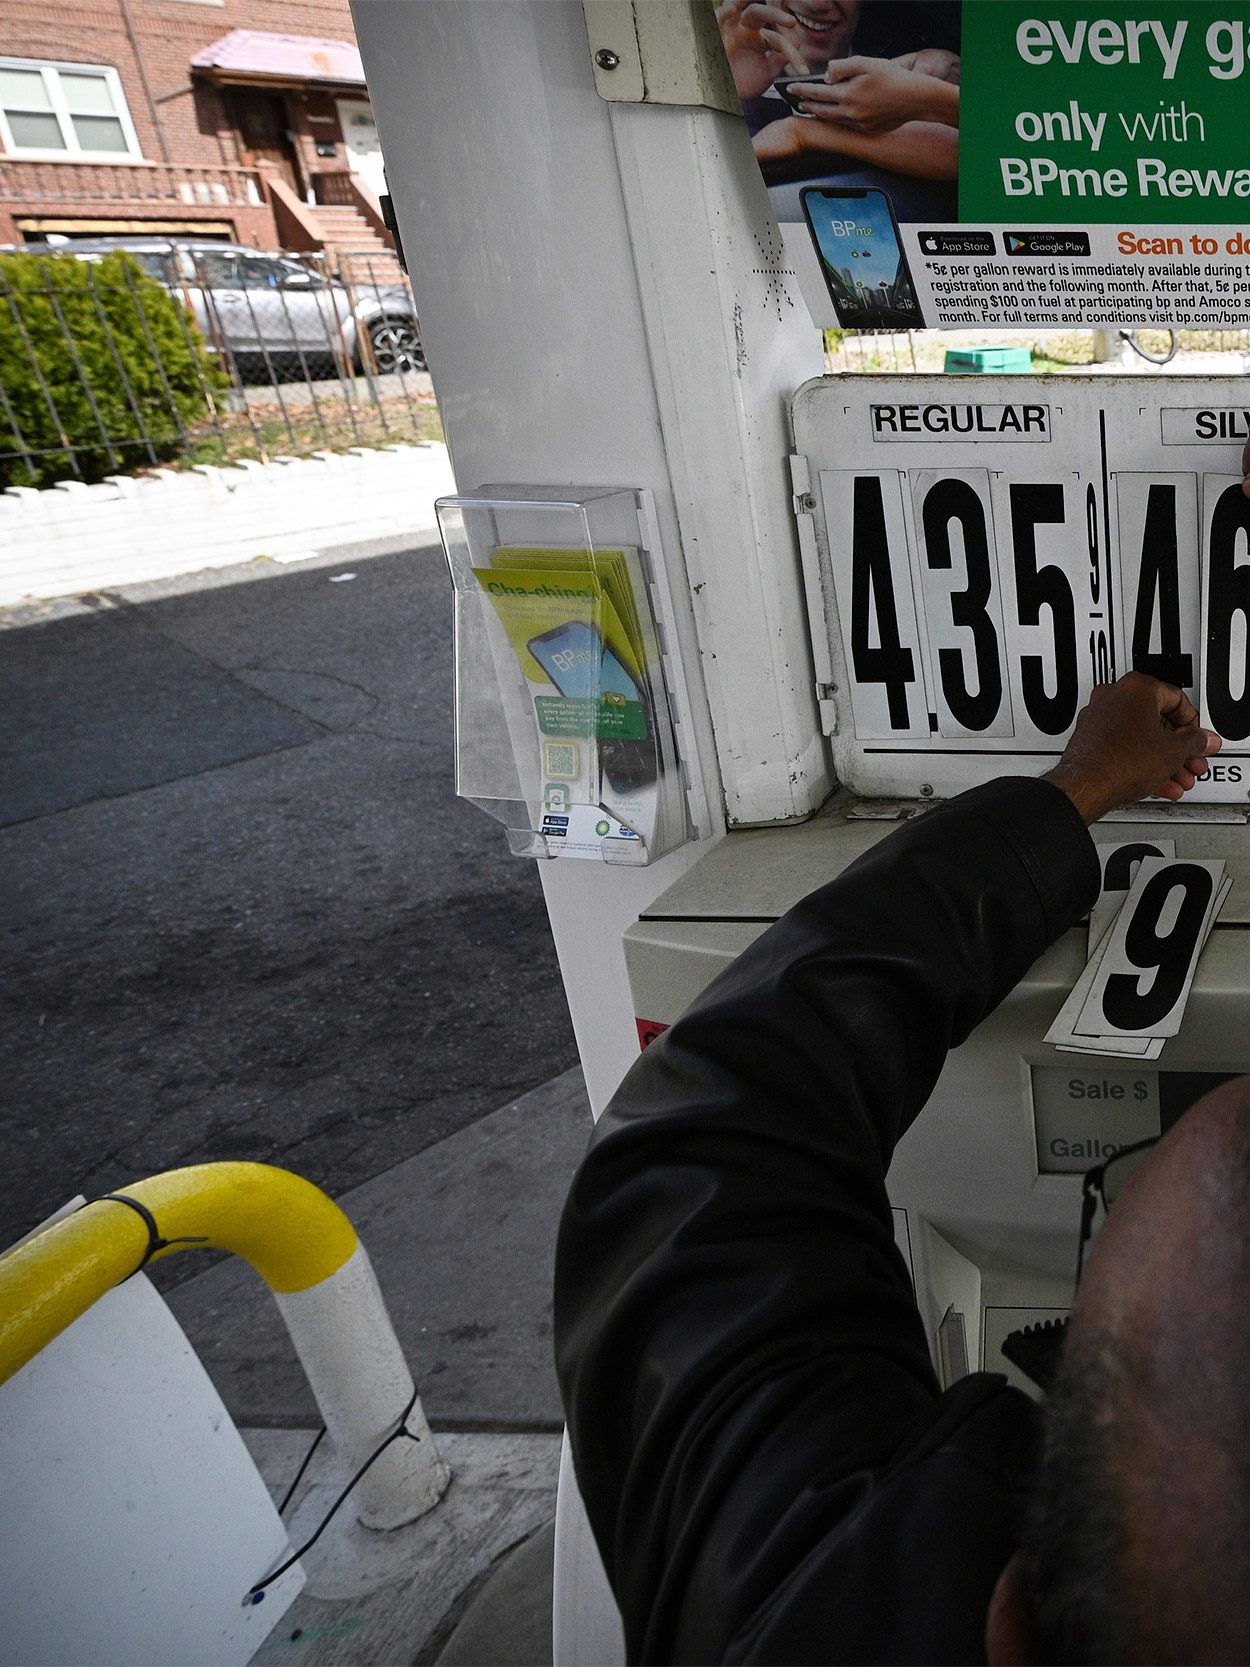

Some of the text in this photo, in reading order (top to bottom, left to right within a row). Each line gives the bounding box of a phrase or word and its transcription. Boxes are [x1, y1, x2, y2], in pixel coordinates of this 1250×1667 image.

[1016, 19, 1188, 79] every
[1015, 100, 1205, 151] only with
[999, 158, 1128, 197] BPme
[942, 242, 990, 252] App Store
[1030, 242, 1084, 253] Google Play
[1117, 231, 1184, 255] Scan
[1189, 234, 1218, 255] to
[950, 266, 970, 278] per
[973, 262, 1010, 278] gallon
[1012, 262, 1056, 276] reward
[1058, 262, 1070, 276] is
[1071, 262, 1145, 278] immediately
[1148, 263, 1201, 276] available
[1204, 263, 1242, 278] during
[930, 278, 1000, 294] registration
[1002, 279, 1025, 292] and
[1026, 279, 1047, 292] the
[1048, 279, 1105, 295] following
[1107, 279, 1149, 292] month.
[1152, 279, 1183, 292] After
[1184, 280, 1213, 294] that,
[934, 294, 989, 310] spending
[990, 294, 1018, 308] $100
[1021, 298, 1036, 307] on
[1038, 295, 1061, 307] fuel
[1064, 296, 1077, 308] at
[1078, 295, 1153, 310] participating
[1155, 295, 1171, 310] bp
[1174, 295, 1196, 308] and
[1199, 295, 1241, 308] Amoco
[938, 310, 980, 322] month.
[981, 310, 1001, 322] For
[1003, 310, 1022, 322] full
[1023, 312, 1059, 322] terms
[1061, 310, 1083, 322] and
[1086, 310, 1147, 323] conditions
[1148, 310, 1174, 322] visit
[874, 406, 1046, 432] REGULAR
[1102, 864, 1212, 1030] 9
[1068, 1080, 1148, 1102] Sale $
